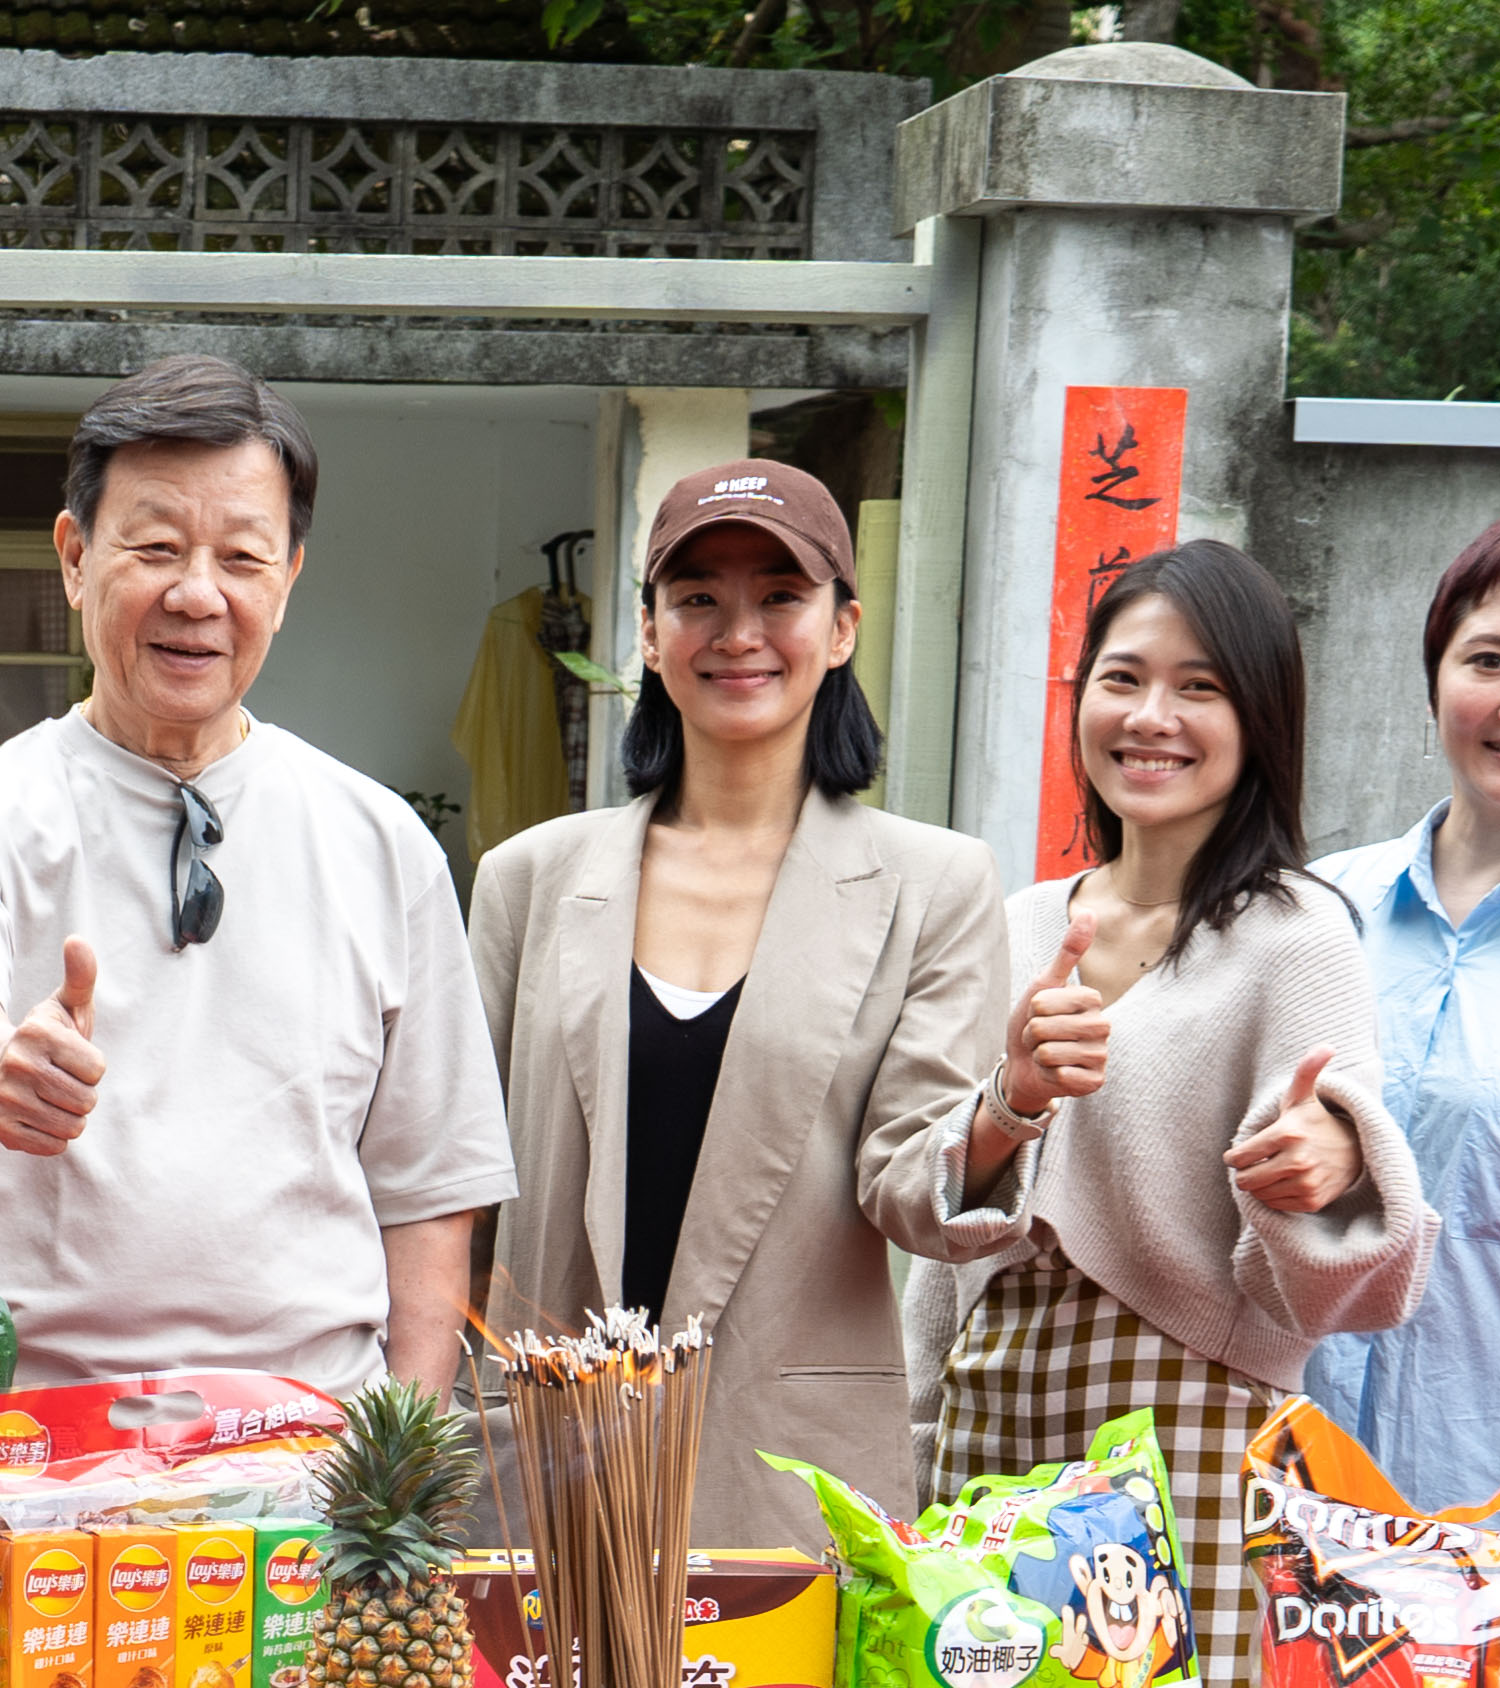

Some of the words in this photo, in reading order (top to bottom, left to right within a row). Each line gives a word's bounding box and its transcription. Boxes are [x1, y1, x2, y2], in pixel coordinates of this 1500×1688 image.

[106, 1615, 170, 1648] 樂連連
[184, 1610, 246, 1640] 樂連連
[1276, 1597, 1459, 1643] Doritos
[22, 1621, 89, 1654] 樂連連
[941, 1645, 1041, 1675] 奶油椰子
